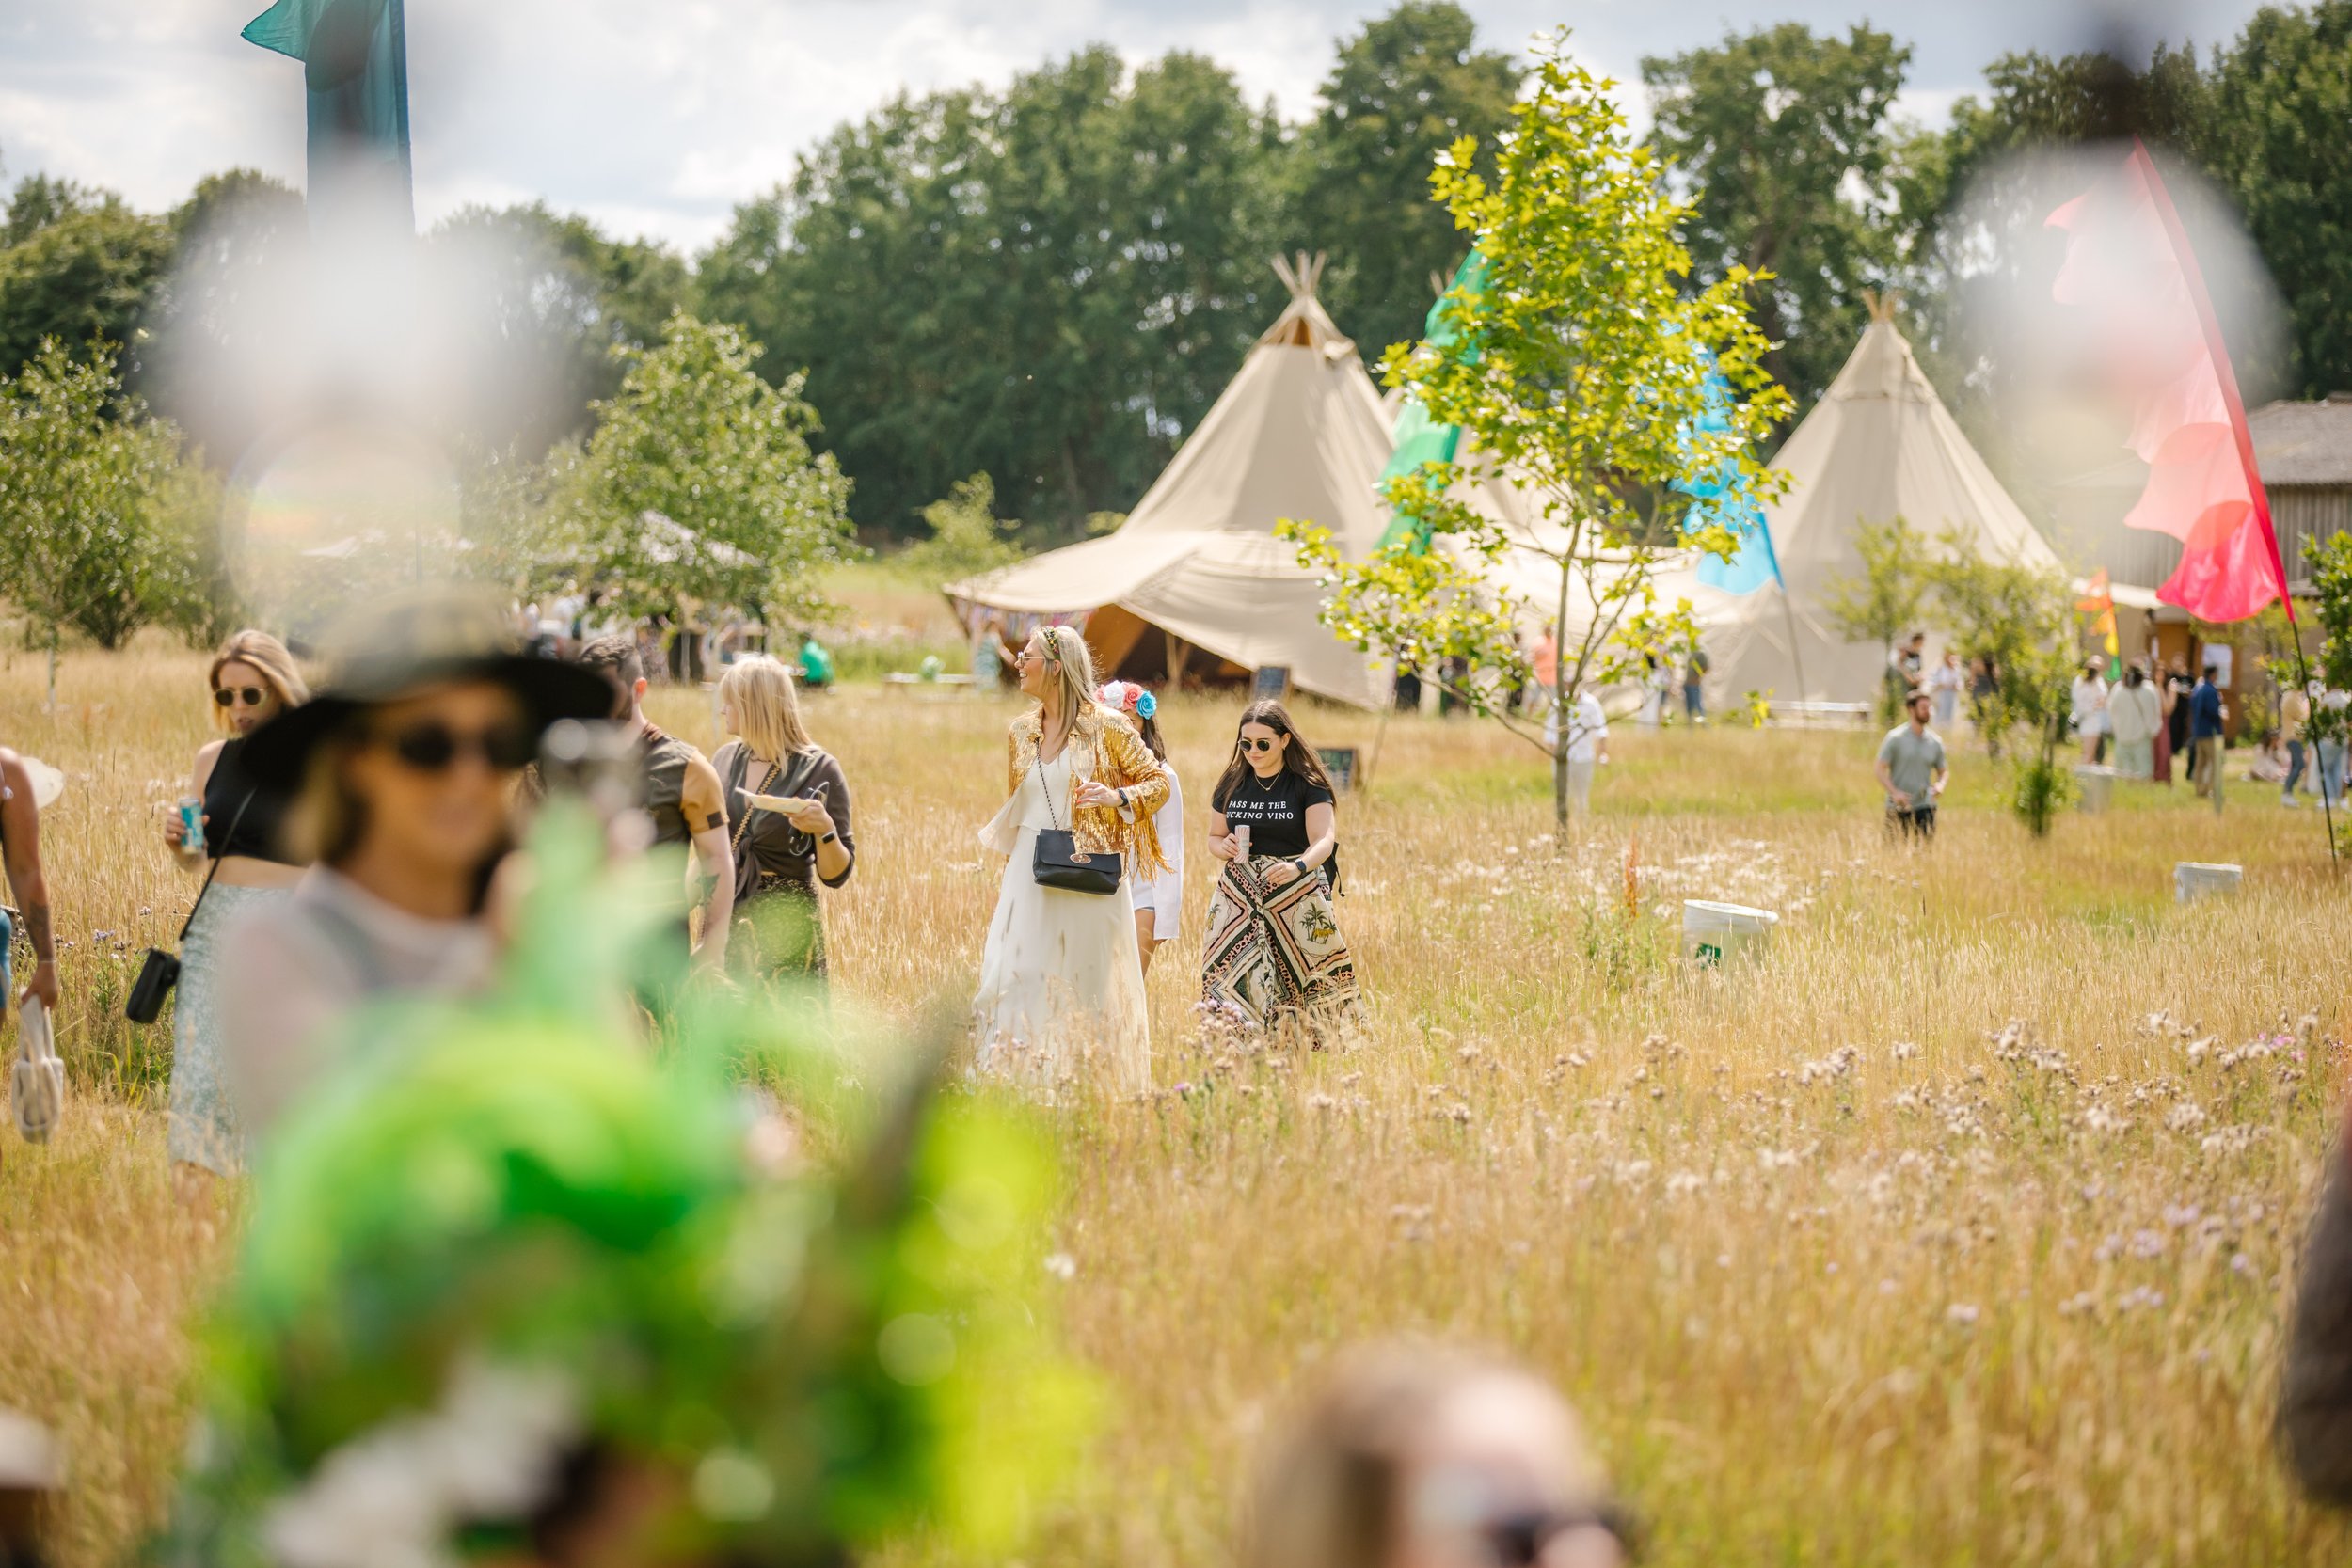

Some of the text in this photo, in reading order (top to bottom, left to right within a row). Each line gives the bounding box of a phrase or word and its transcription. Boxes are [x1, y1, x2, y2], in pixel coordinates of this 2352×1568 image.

[1229, 800, 1287, 810] PASS ME THE
[1226, 811, 1294, 820] UCKING VINO
